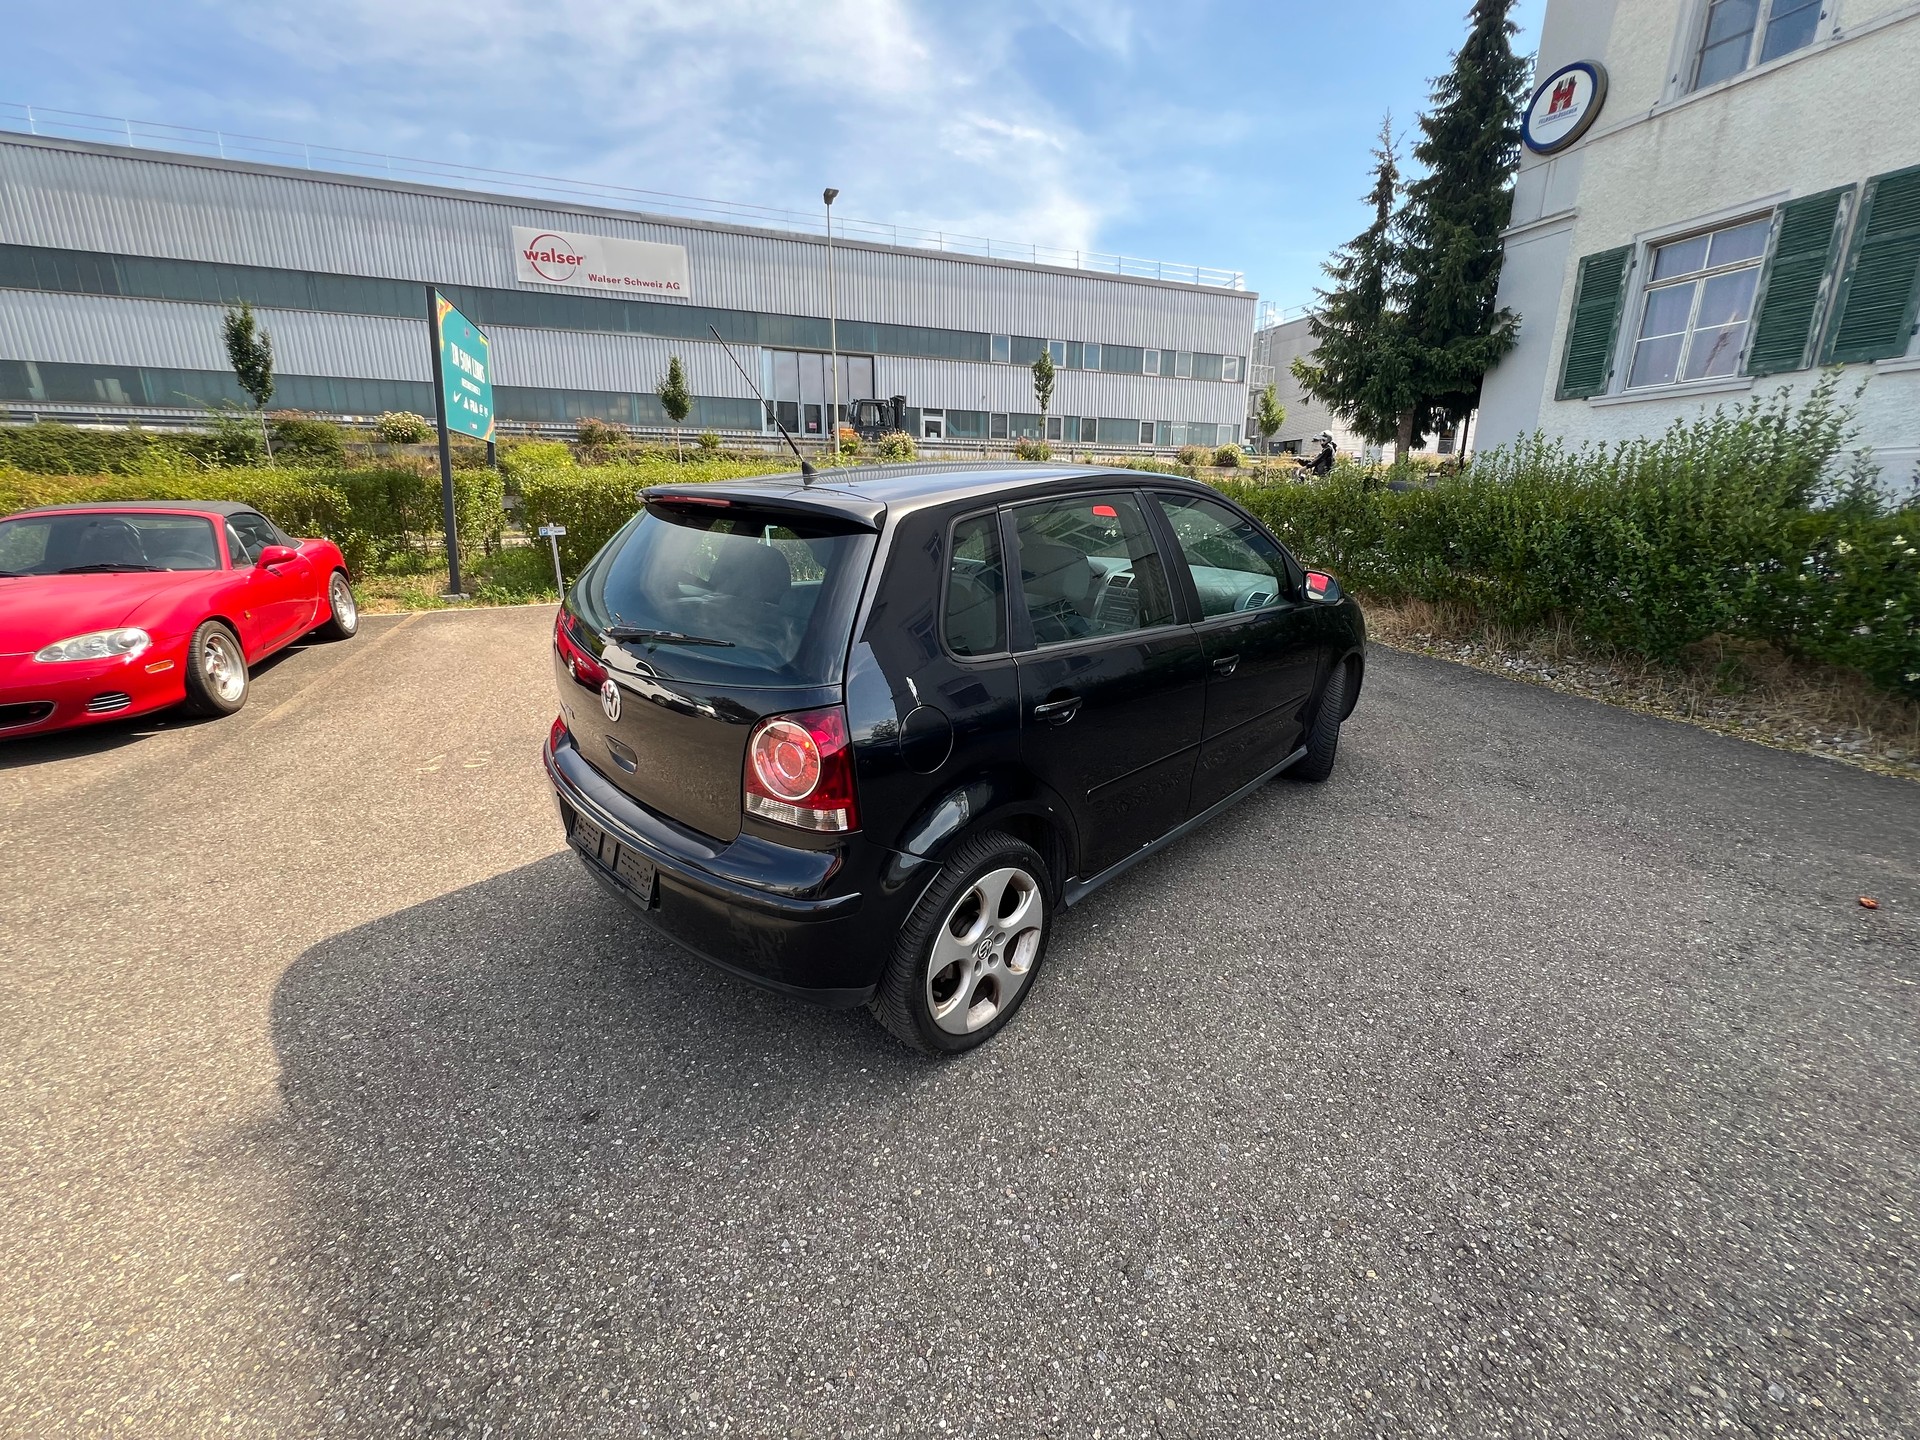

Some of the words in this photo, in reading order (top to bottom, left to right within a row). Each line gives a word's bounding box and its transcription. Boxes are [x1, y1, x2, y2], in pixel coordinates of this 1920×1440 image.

[523, 247, 584, 266] walser
[588, 273, 622, 285] Walser
[624, 276, 663, 289] Schweiz
[665, 281, 681, 291] AG
